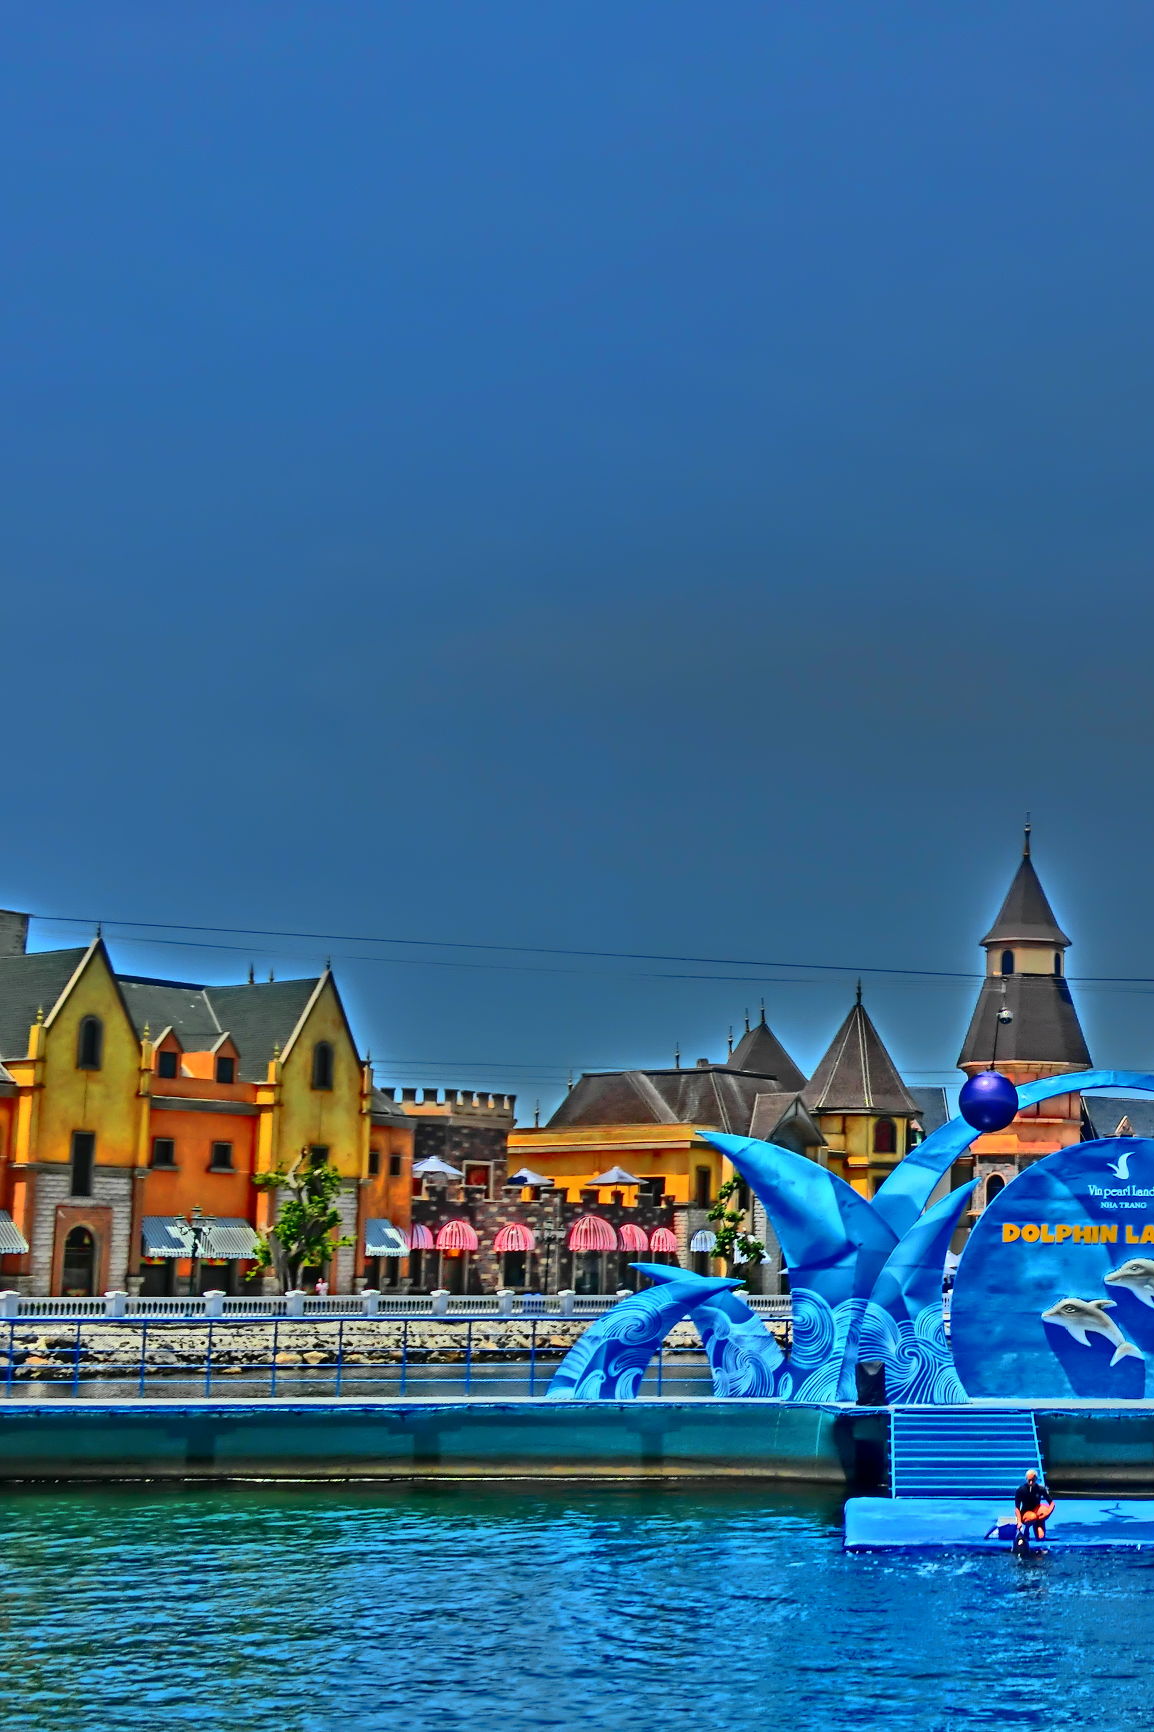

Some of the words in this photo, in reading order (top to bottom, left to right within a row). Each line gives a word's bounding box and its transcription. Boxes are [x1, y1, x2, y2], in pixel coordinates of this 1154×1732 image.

[1100, 1201, 1118, 1209] NHA
[1119, 1201, 1148, 1209] TRANG
[1002, 1223, 1119, 1244] DOLPHIN
